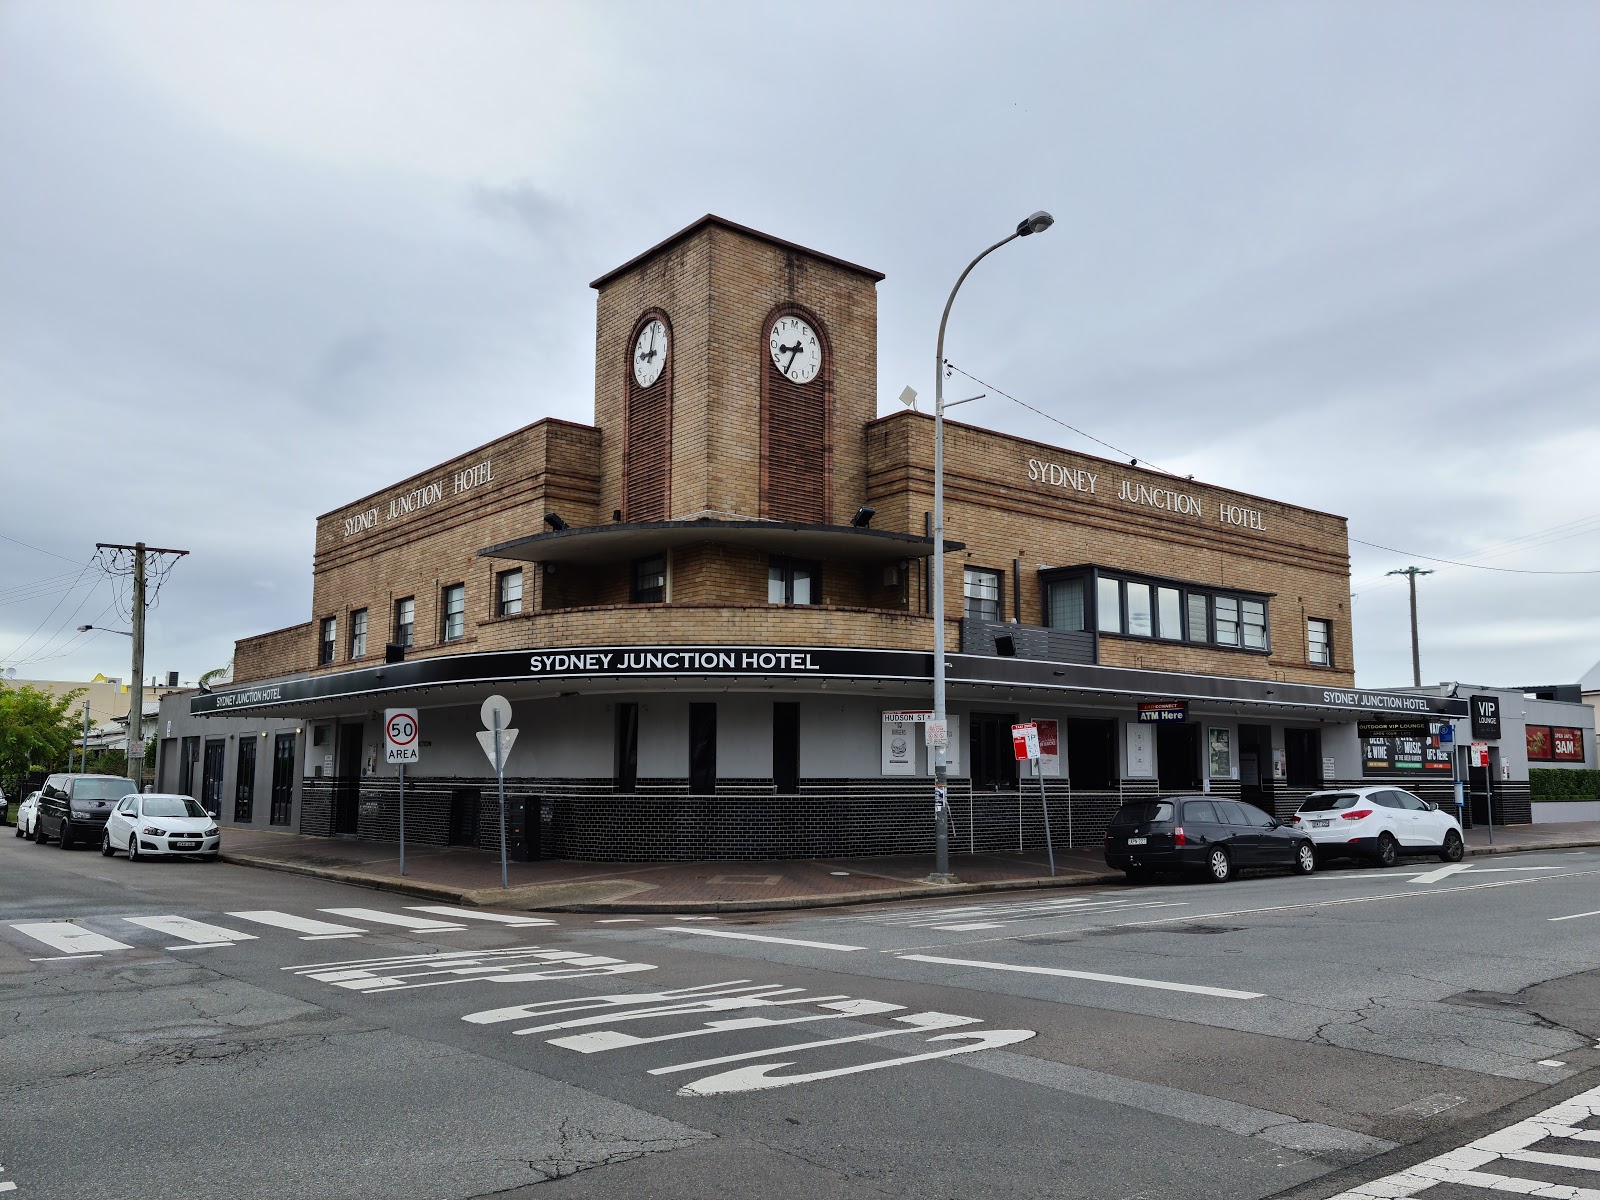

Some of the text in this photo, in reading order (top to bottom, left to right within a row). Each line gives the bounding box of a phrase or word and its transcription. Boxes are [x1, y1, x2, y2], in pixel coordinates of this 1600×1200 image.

[344, 460, 495, 536] SYDNEY JUNCTION HOTEL
[1028, 459, 1267, 531] SYDNEY JUNCTION HOTEL
[530, 652, 820, 672] SYDNEY JUNCTION HOTEL
[216, 688, 281, 707] SYDNEY JUNCTION HOTEL
[1323, 691, 1430, 710] SYDNEY JUNCTION HOTEL
[1140, 711, 1184, 720] ATM Here
[1478, 701, 1496, 717] VIP
[884, 714, 914, 722] HUDSON
[391, 723, 413, 737] 50
[388, 749, 417, 759] AREA
[1372, 746, 1388, 759] WINE
[1404, 742, 1422, 754] MUSIC
[1426, 748, 1436, 760] UFC
[1555, 740, 1574, 754] 3AM
